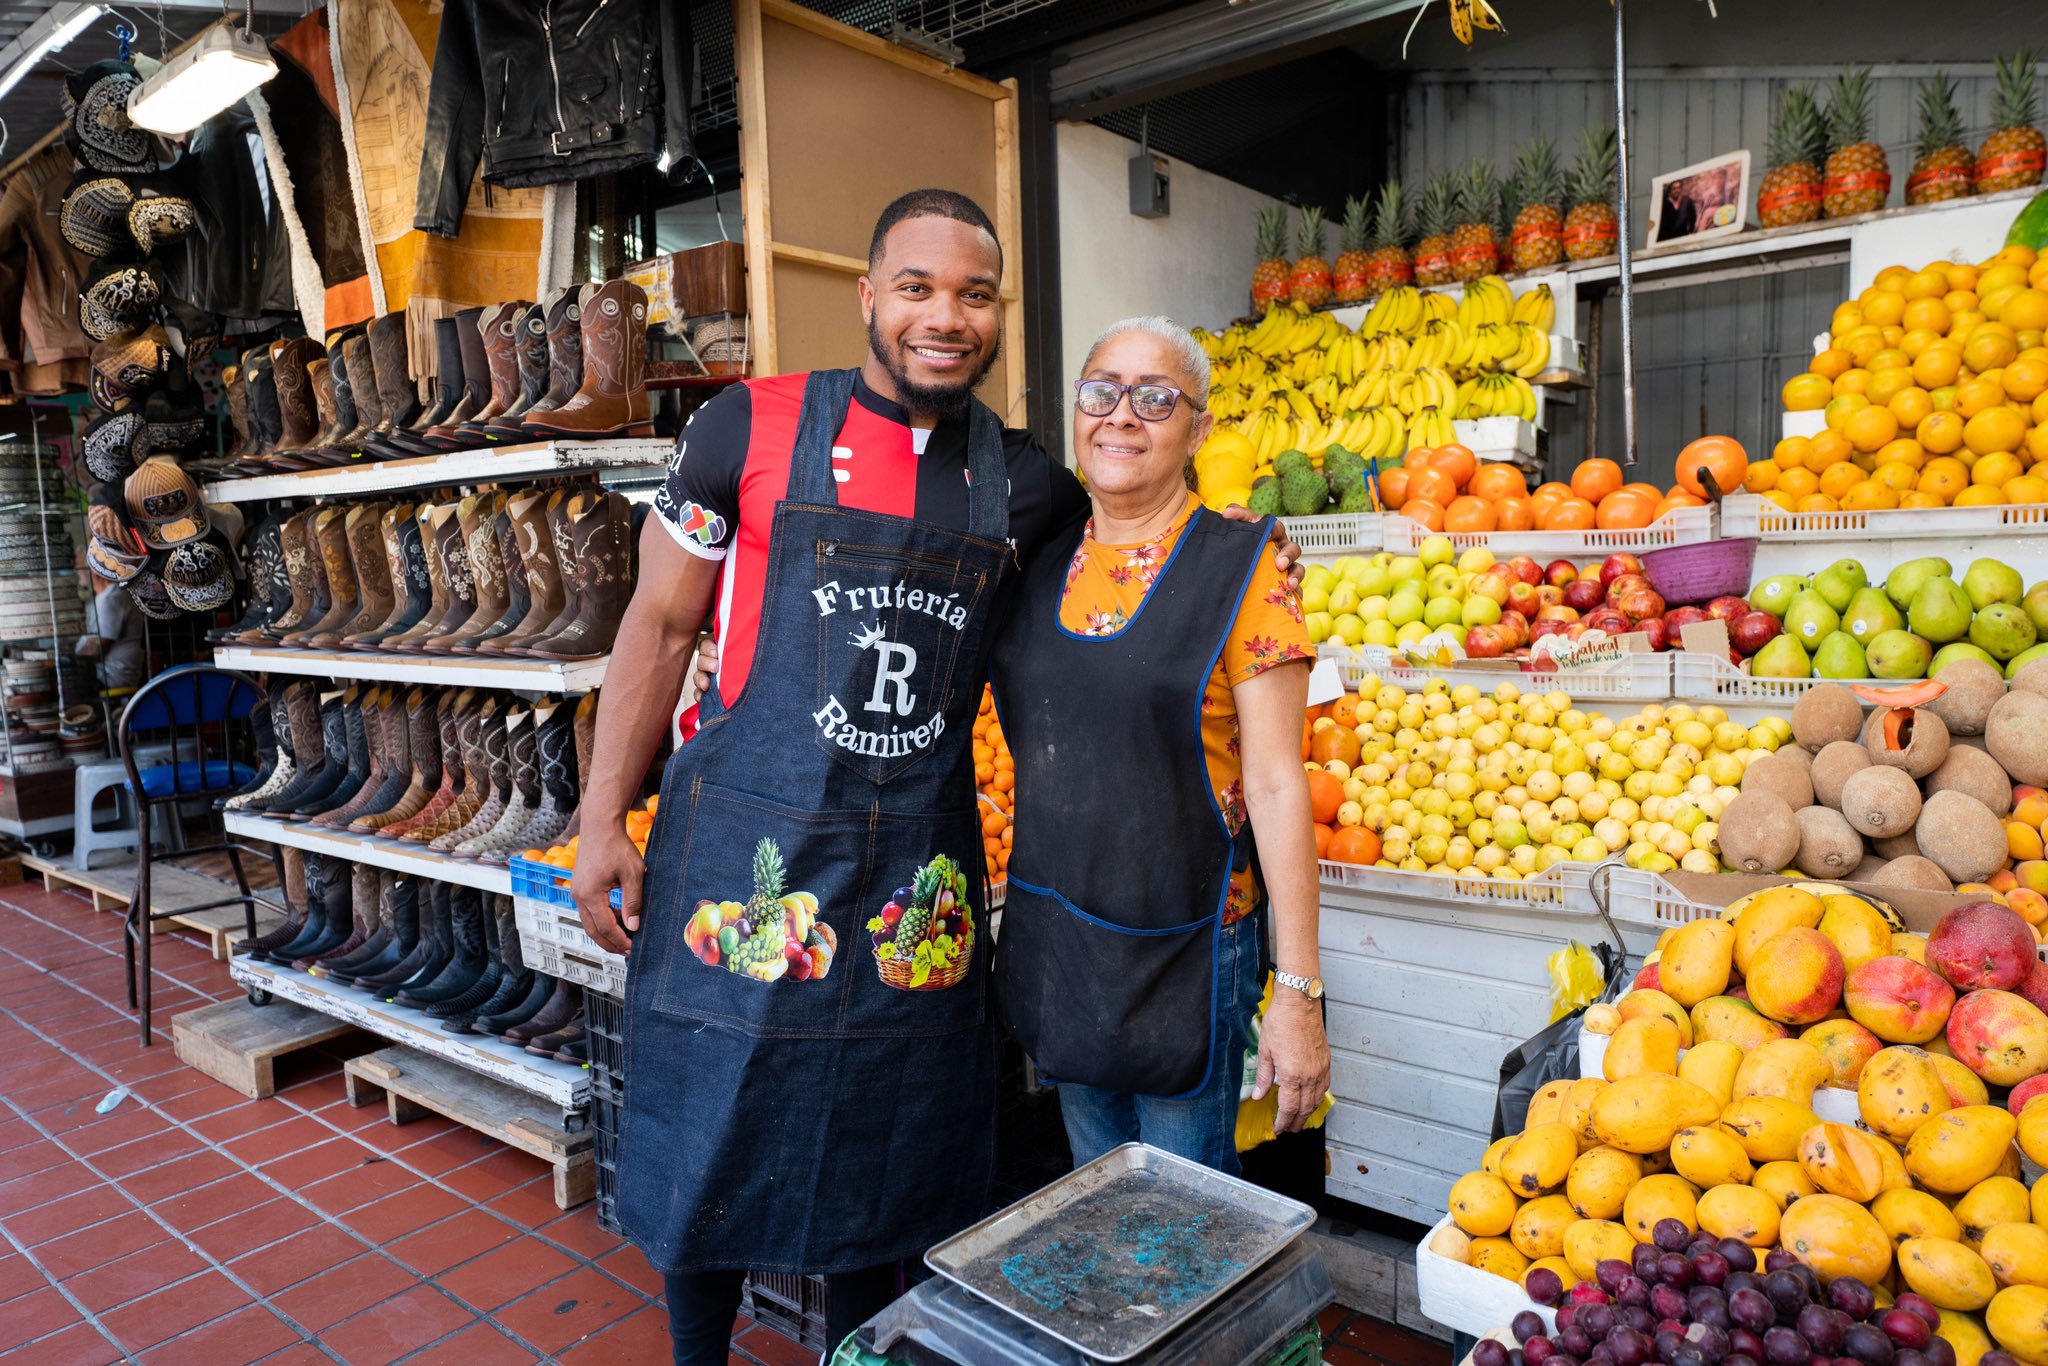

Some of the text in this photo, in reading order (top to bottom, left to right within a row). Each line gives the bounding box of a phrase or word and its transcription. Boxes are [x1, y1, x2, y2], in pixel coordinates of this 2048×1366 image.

[811, 579, 967, 631] Frutería
[863, 640, 918, 717] R
[1603, 650, 1623, 661] vida
[811, 693, 946, 759] Ramirez
